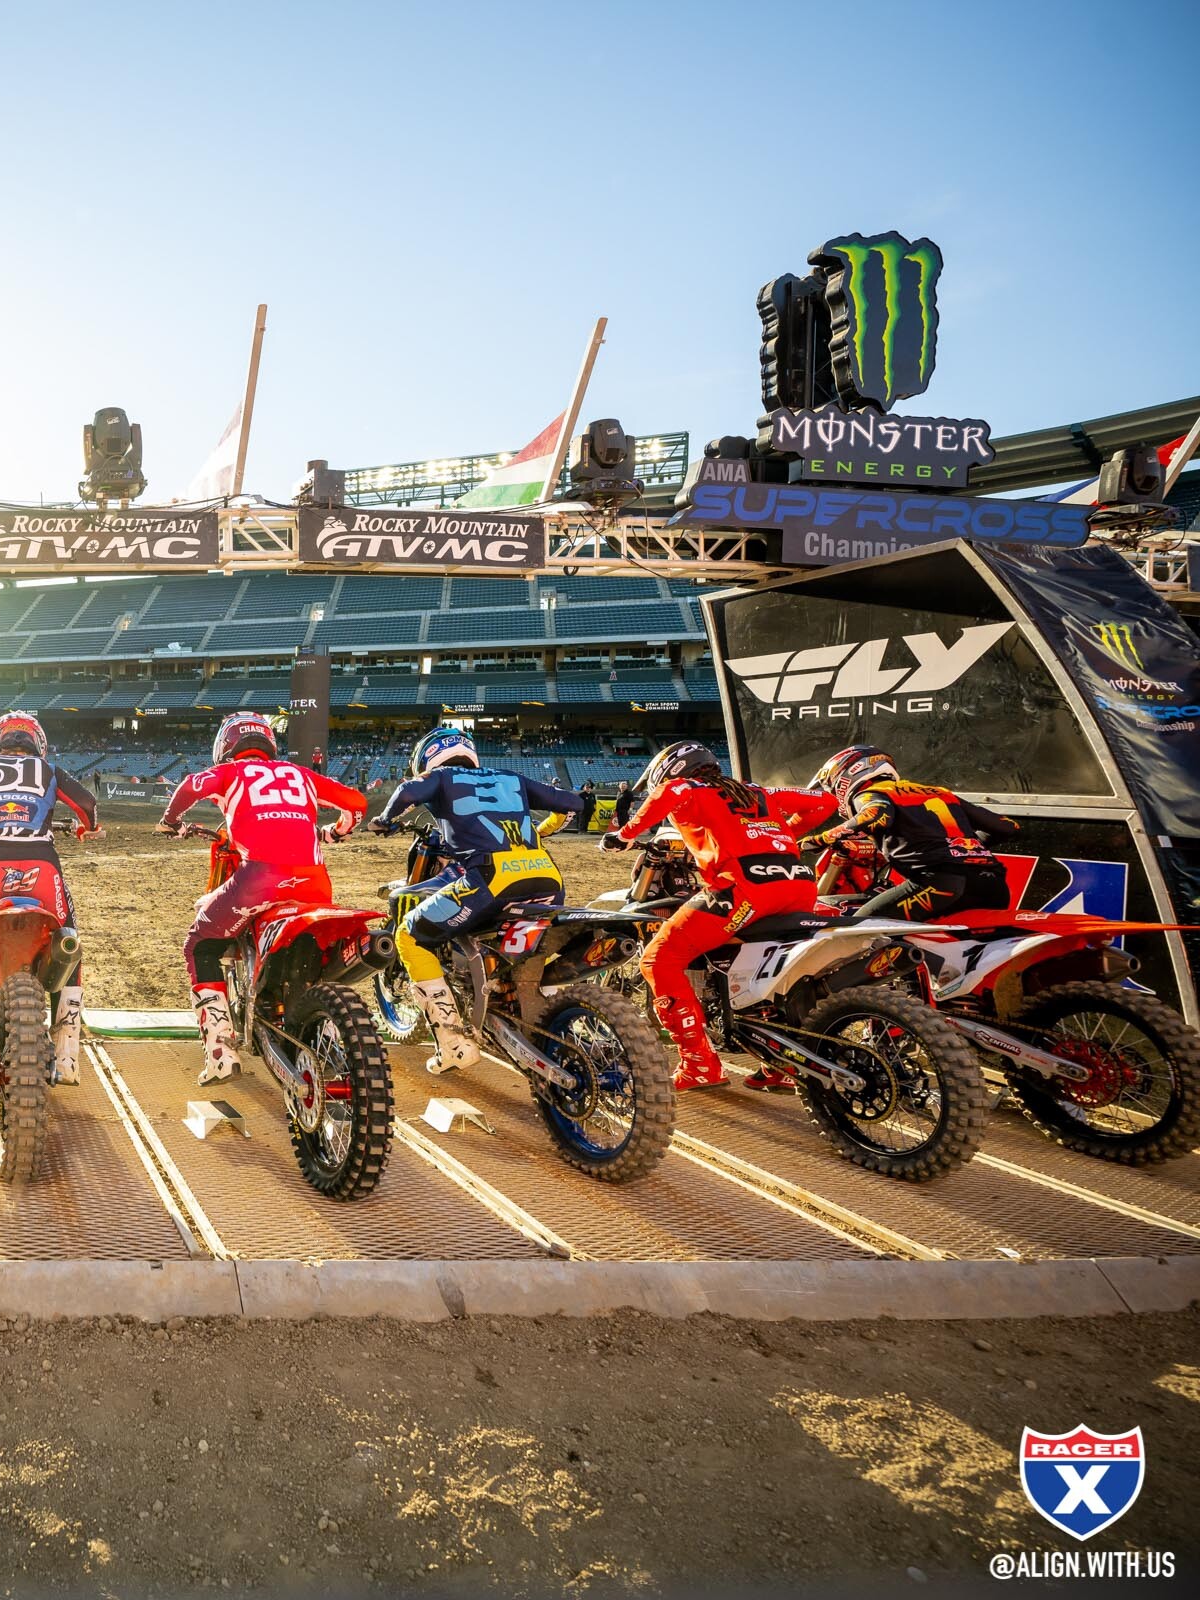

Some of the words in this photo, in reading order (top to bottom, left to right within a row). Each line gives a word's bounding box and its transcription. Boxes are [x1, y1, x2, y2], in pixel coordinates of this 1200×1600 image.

[777, 412, 989, 456] MONSTER
[702, 462, 748, 483] AMA
[811, 459, 959, 478] ENERGY
[10, 515, 82, 533] ROCKY
[86, 514, 202, 534] MOUNTAIN
[351, 514, 421, 533] ROCKY
[423, 516, 529, 538] MOUNTAIN
[692, 485, 1095, 547] SUPERCROSS
[724, 621, 1018, 704] FLY
[772, 697, 933, 720] RACING
[239, 725, 265, 735] CHASE
[850, 762, 862, 774] BELL
[244, 764, 308, 807] 23
[13, 813, 30, 823] Bull
[256, 811, 310, 822] HONDA
[501, 857, 553, 874] ASTARS
[53, 873, 67, 920] GASGAS
[567, 912, 616, 921] DUNLOP
[504, 921, 538, 953] 3
[757, 943, 798, 980] 27
